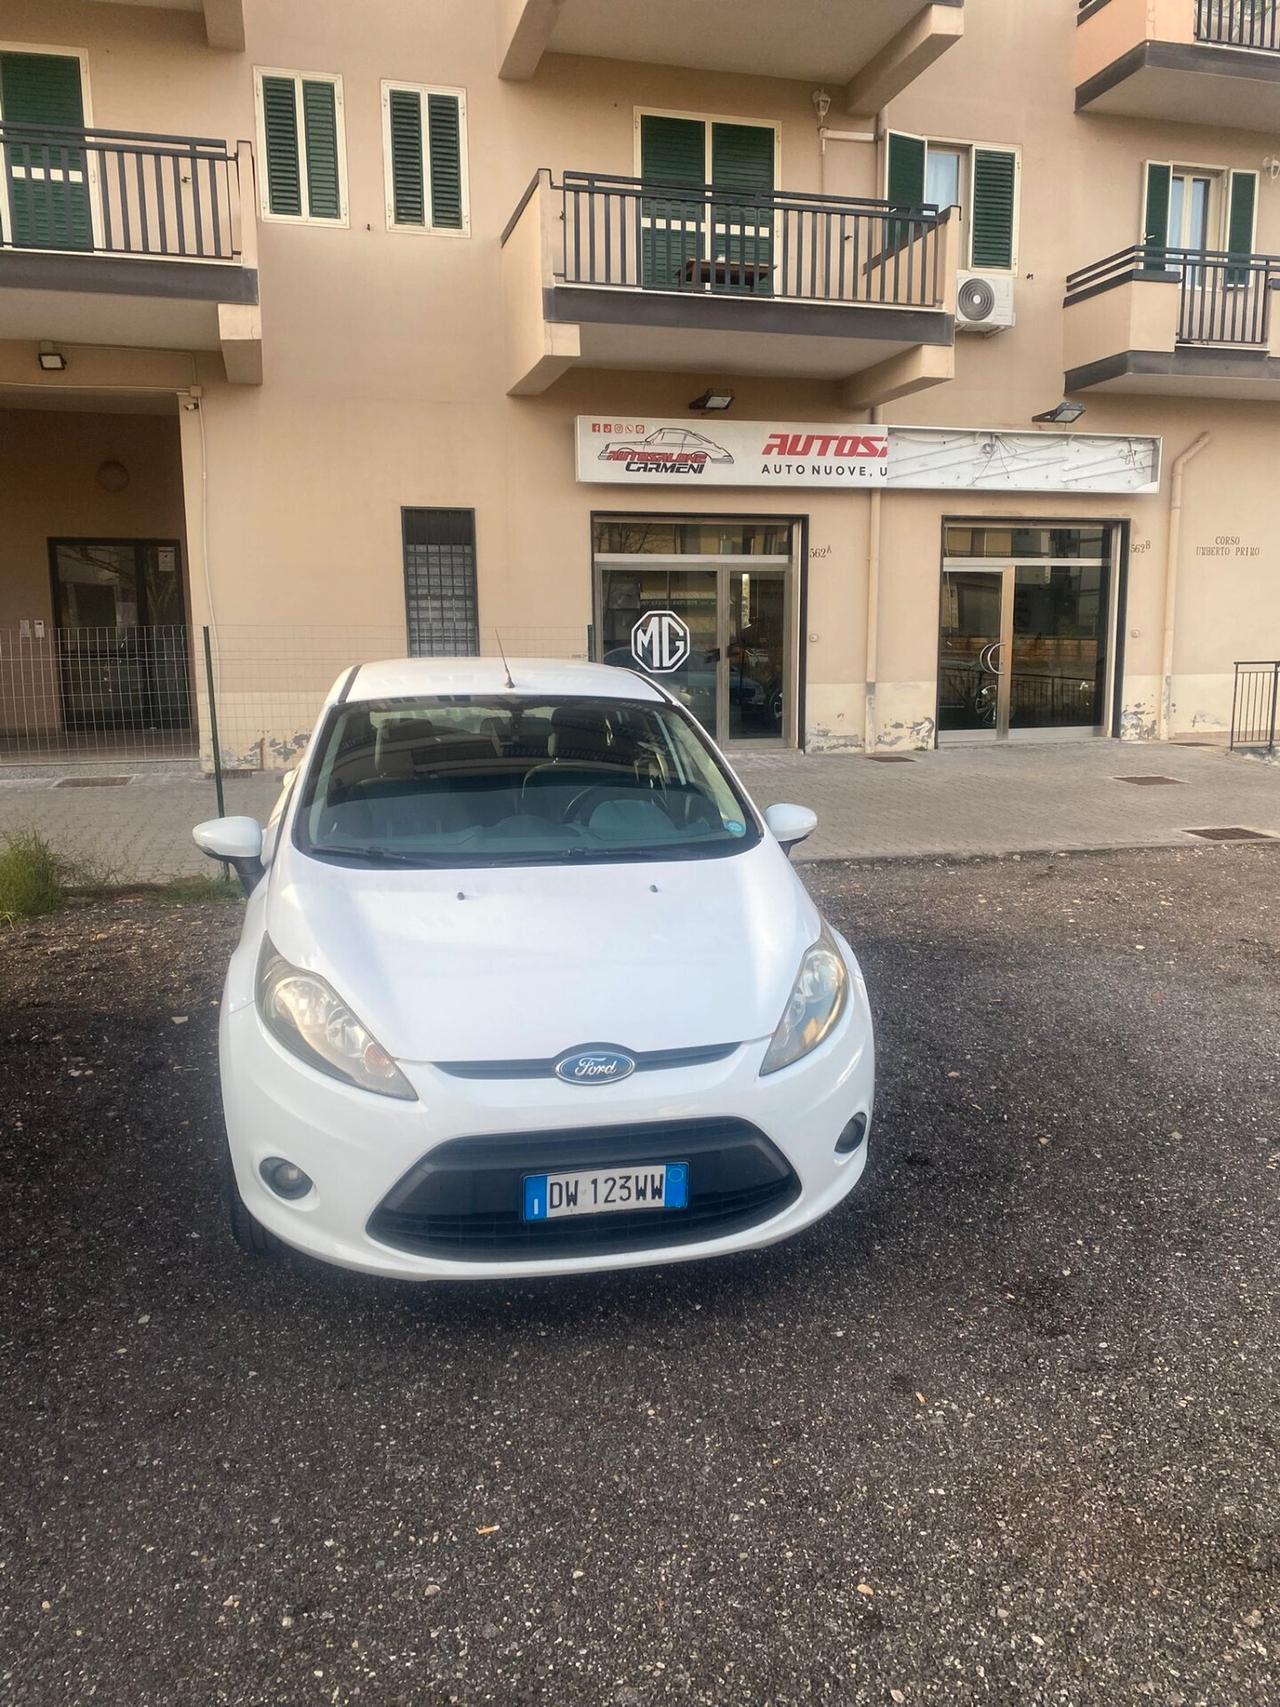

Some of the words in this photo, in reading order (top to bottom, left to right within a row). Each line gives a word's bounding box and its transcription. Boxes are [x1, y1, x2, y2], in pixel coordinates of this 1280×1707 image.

[625, 462, 705, 474] CARMENI
[761, 464, 805, 475] AUTO
[811, 465, 873, 477] NUOVE,
[1215, 536, 1241, 546] CORSO
[1196, 546, 1230, 556] UMBERTO
[1235, 547, 1260, 556] PRIMO
[636, 616, 685, 668] MG
[574, 1056, 618, 1076] Ford
[549, 1180, 579, 1209] DW
[590, 1173, 664, 1204] 123WW
